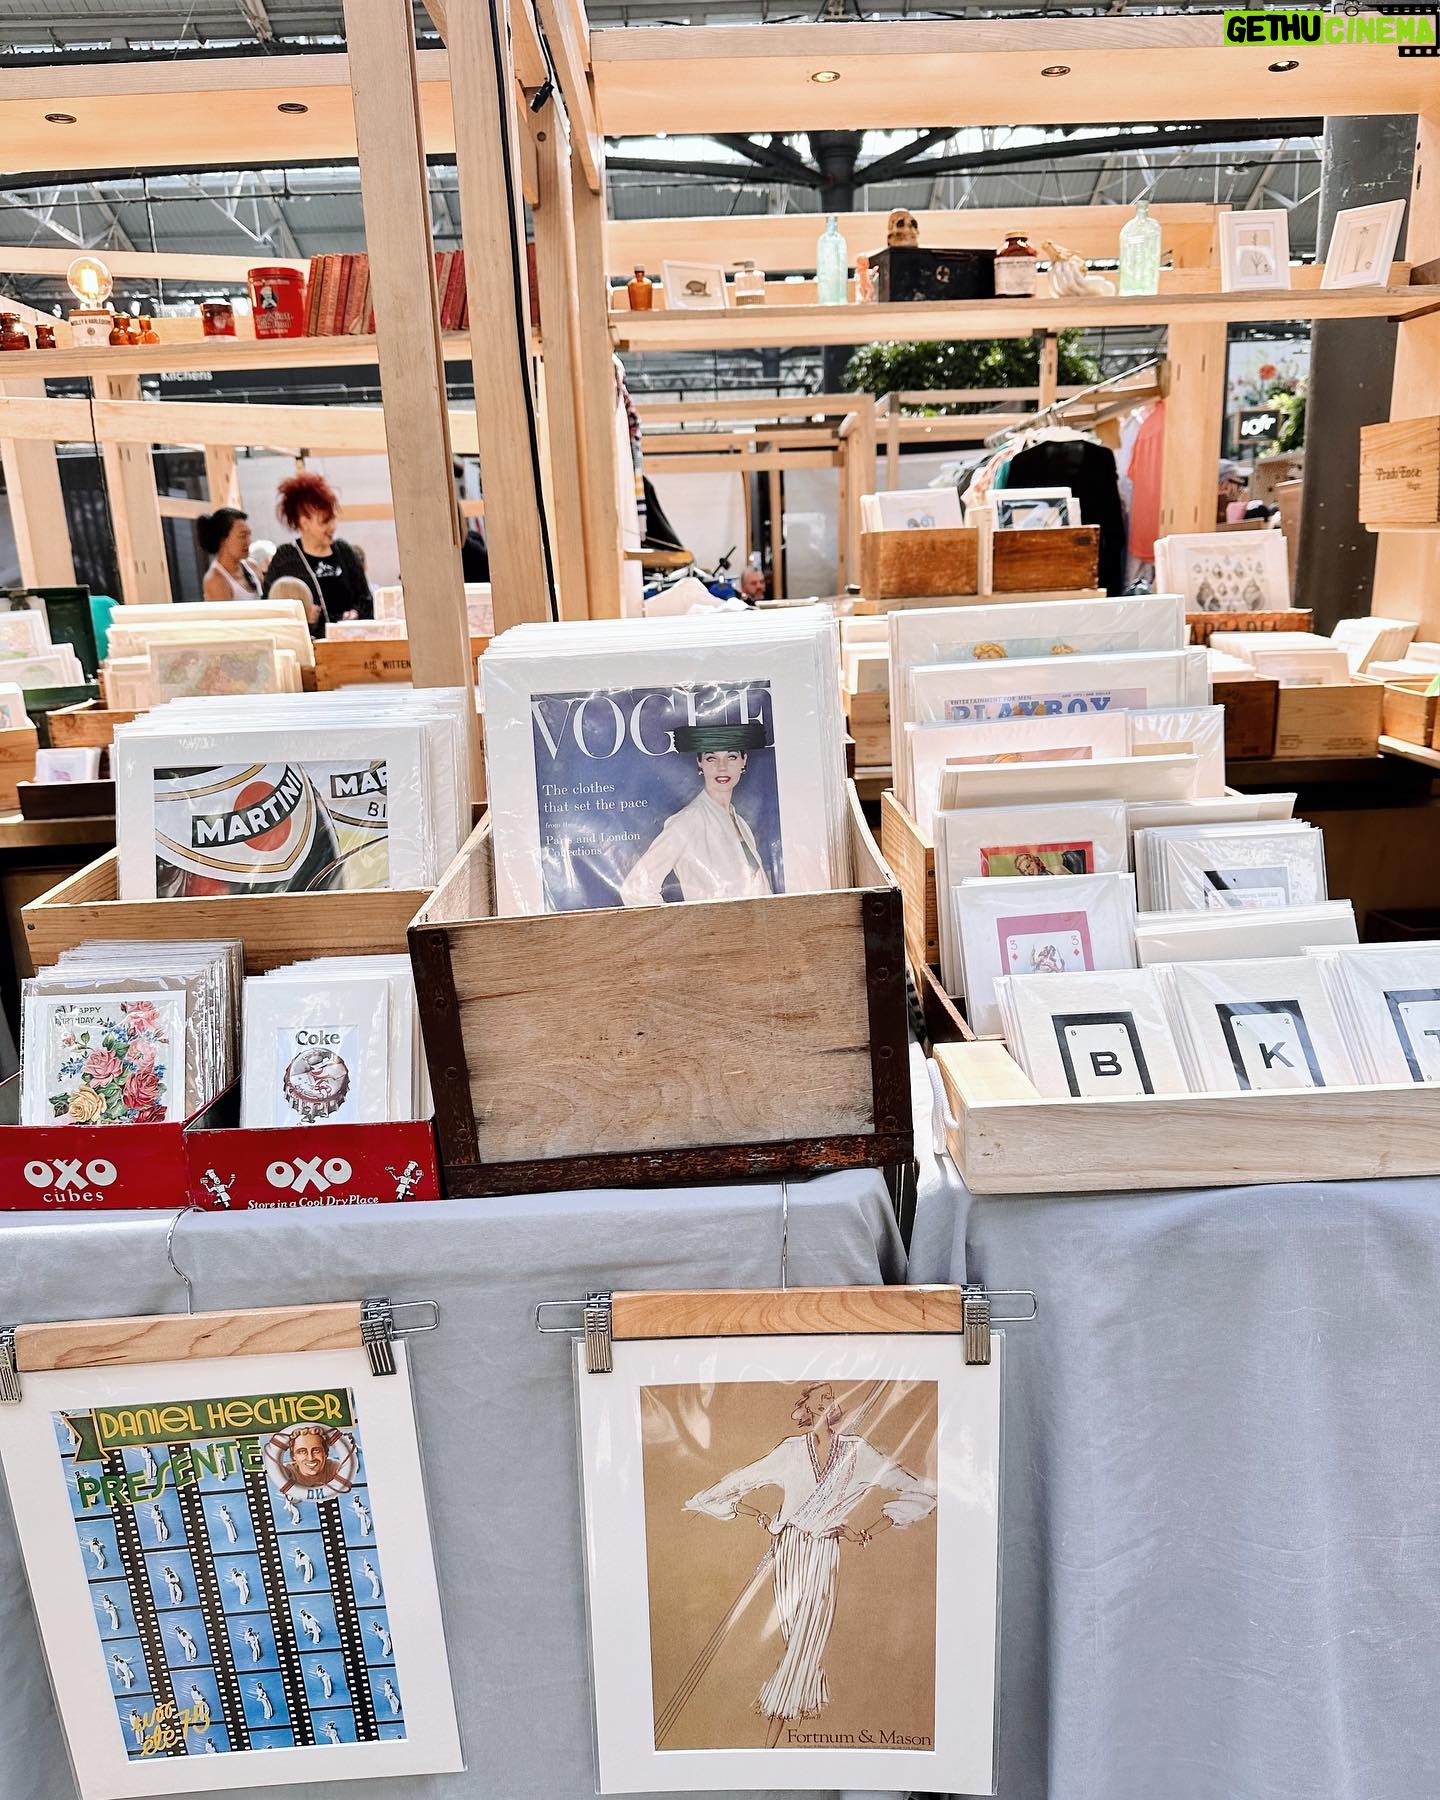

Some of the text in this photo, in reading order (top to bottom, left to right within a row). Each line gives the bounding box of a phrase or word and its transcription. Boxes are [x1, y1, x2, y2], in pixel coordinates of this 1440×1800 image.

[543, 782, 615, 796] The clothes
[196, 769, 303, 845] MARTINI
[544, 798, 648, 813] that set the pace
[546, 831, 641, 845] Pars and London
[545, 845, 602, 858] Coections
[295, 1030, 341, 1046] Coke
[1258, 1041, 1295, 1069] K
[1090, 1051, 1123, 1077] B
[43, 1189, 105, 1204] cubes
[247, 1199, 276, 1210] Store
[277, 1199, 287, 1209] in
[299, 1196, 324, 1208] Cool
[326, 1195, 348, 1206] Dry
[349, 1194, 379, 1205] Place
[79, 1436, 266, 1509] PRESENTE
[787, 1729, 931, 1746] Fortnum & Mason
